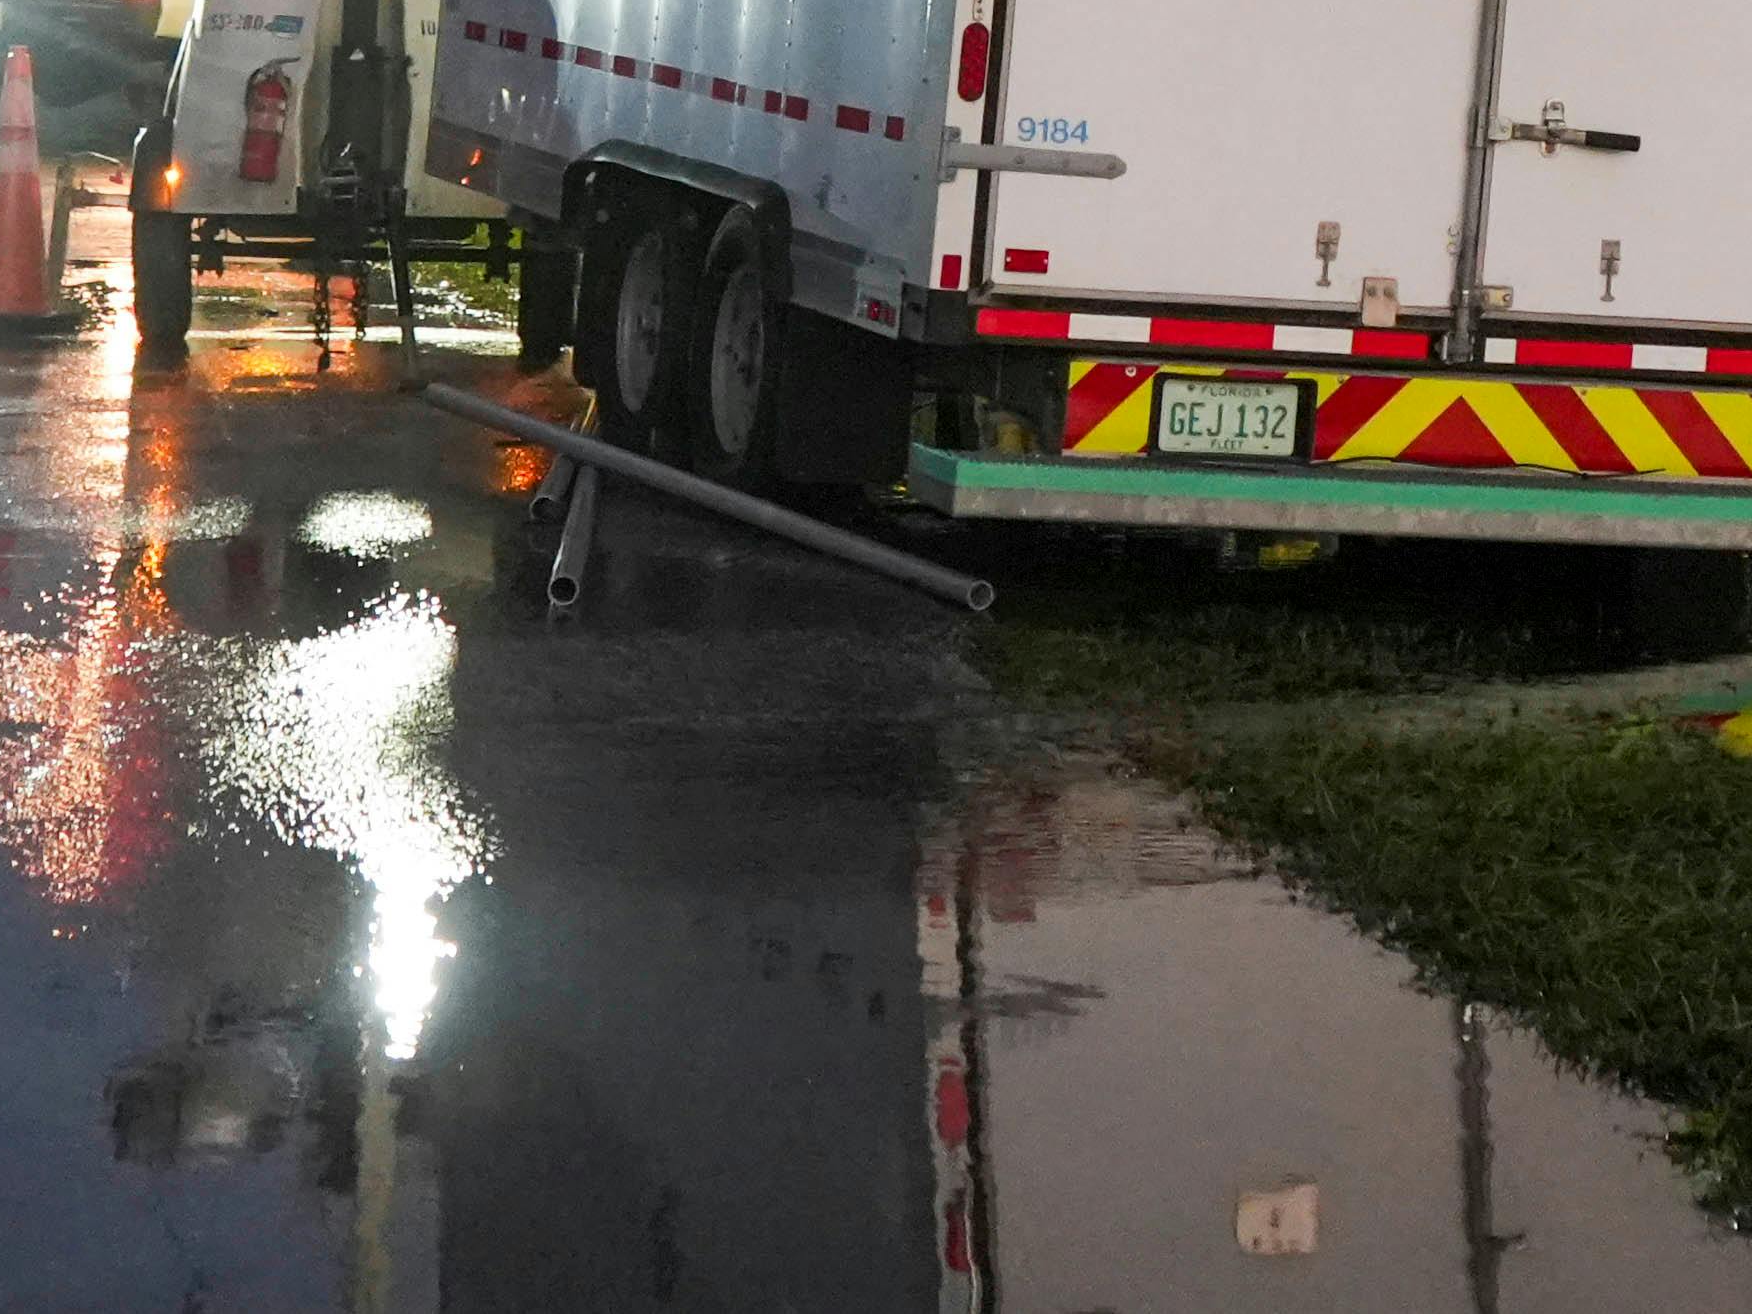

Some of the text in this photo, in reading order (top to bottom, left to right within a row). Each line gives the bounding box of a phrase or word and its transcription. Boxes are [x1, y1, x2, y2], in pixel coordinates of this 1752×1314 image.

[1017, 117, 1089, 145] 9184
[1201, 384, 1261, 398] FLORIDA
[1169, 401, 1288, 439] GEJ 132
[1210, 439, 1245, 451] FLEET
